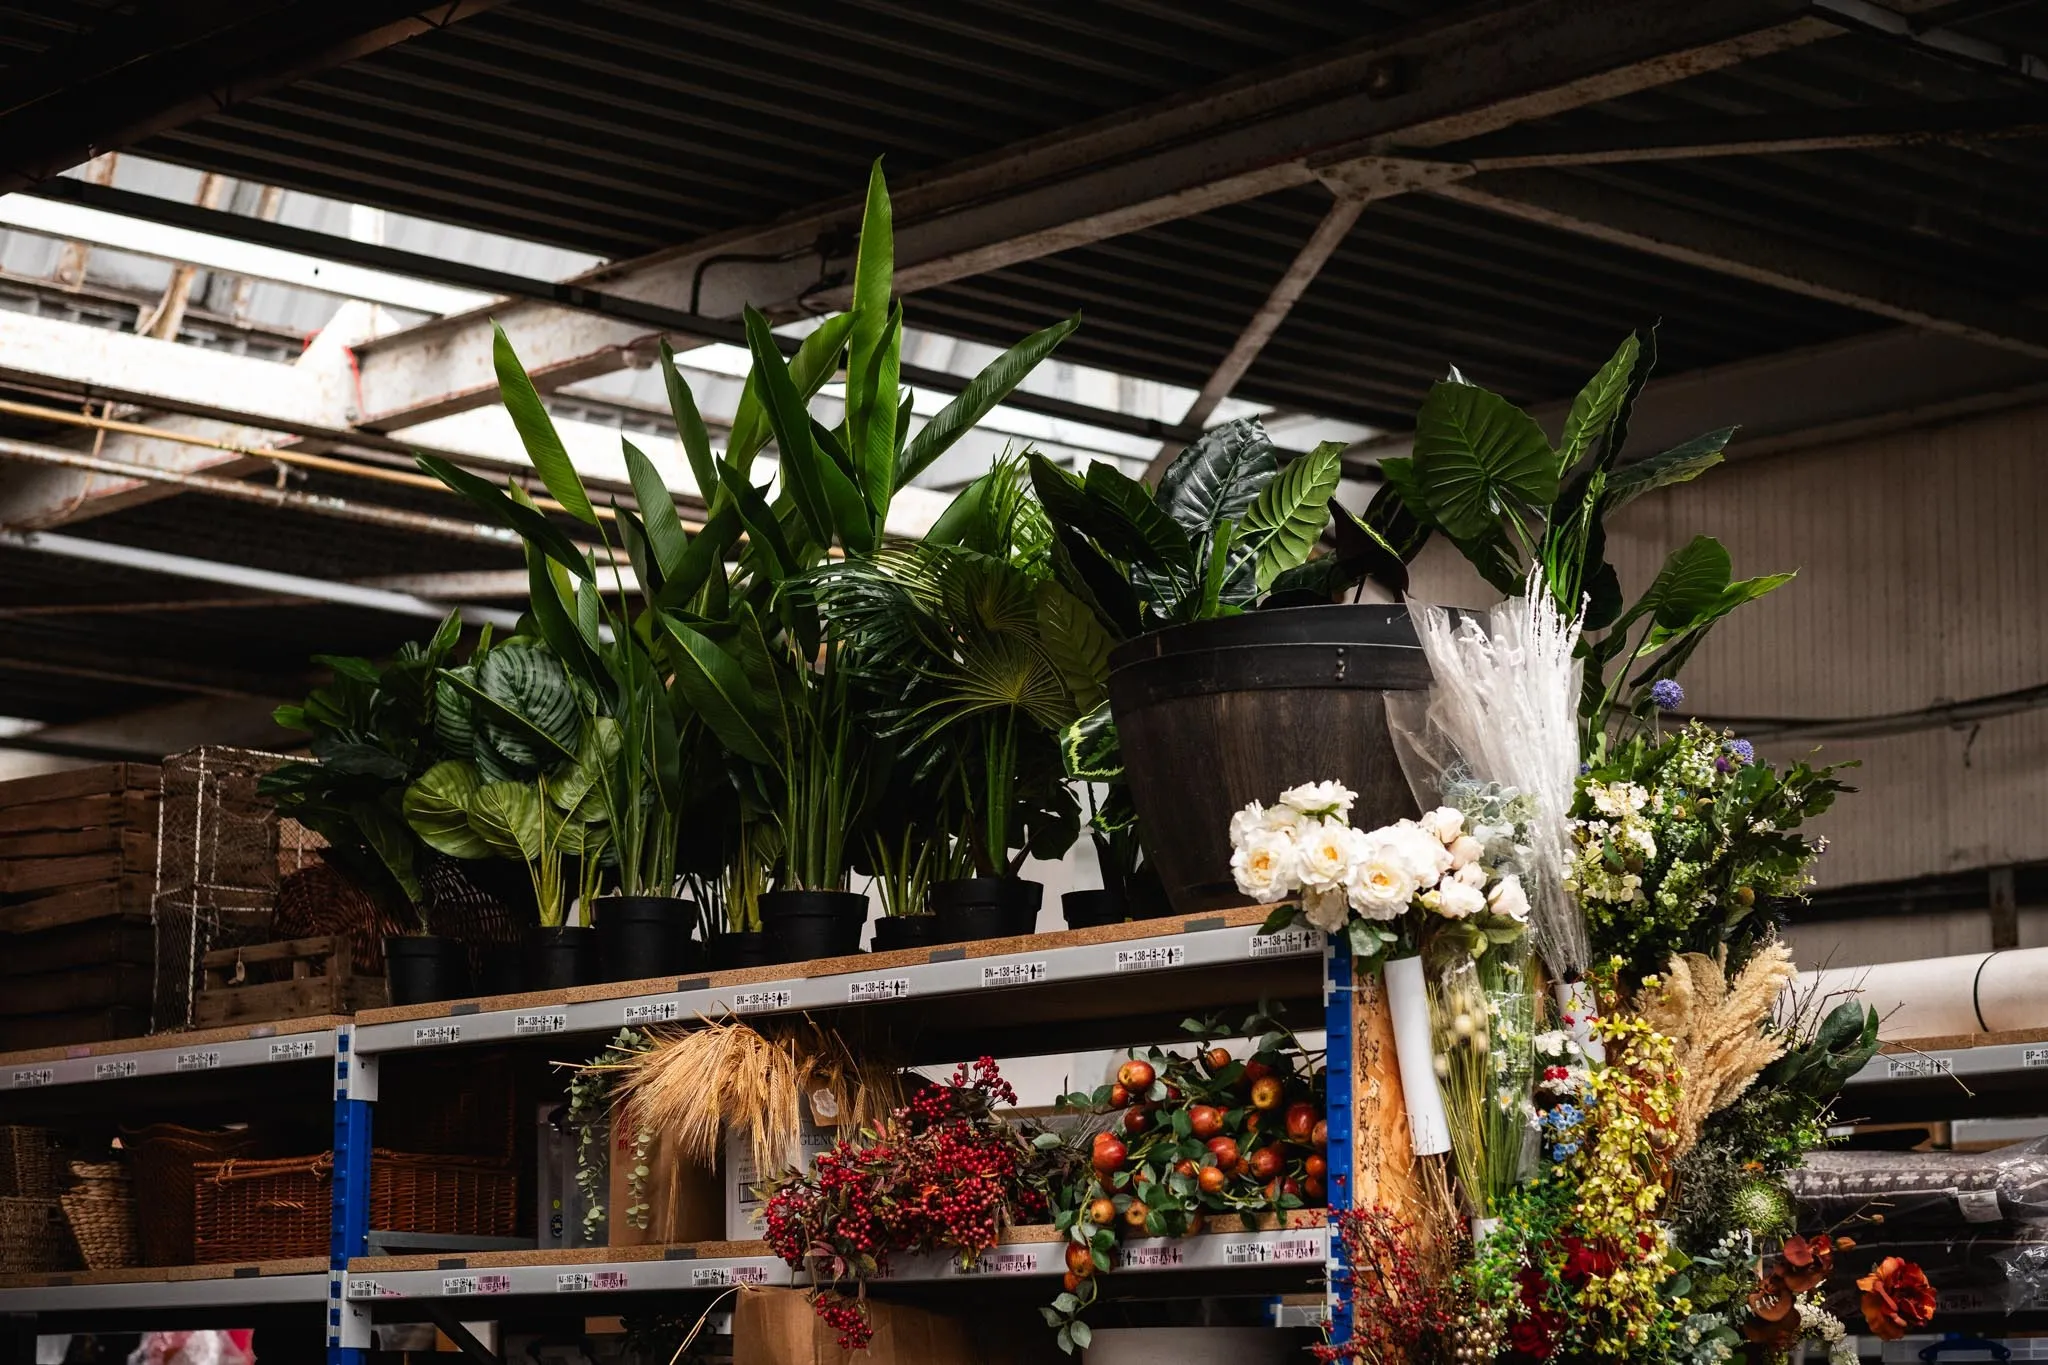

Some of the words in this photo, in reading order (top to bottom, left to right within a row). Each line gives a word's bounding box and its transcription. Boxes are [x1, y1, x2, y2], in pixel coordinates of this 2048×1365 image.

[1118, 948, 1166, 963] BN-138-E-2
[984, 964, 1029, 978] BN-138-E-3
[851, 980, 893, 994] BN-138-E-4
[736, 992, 776, 1005] BN-138-E-5
[626, 1004, 664, 1018] BN-138-E-6
